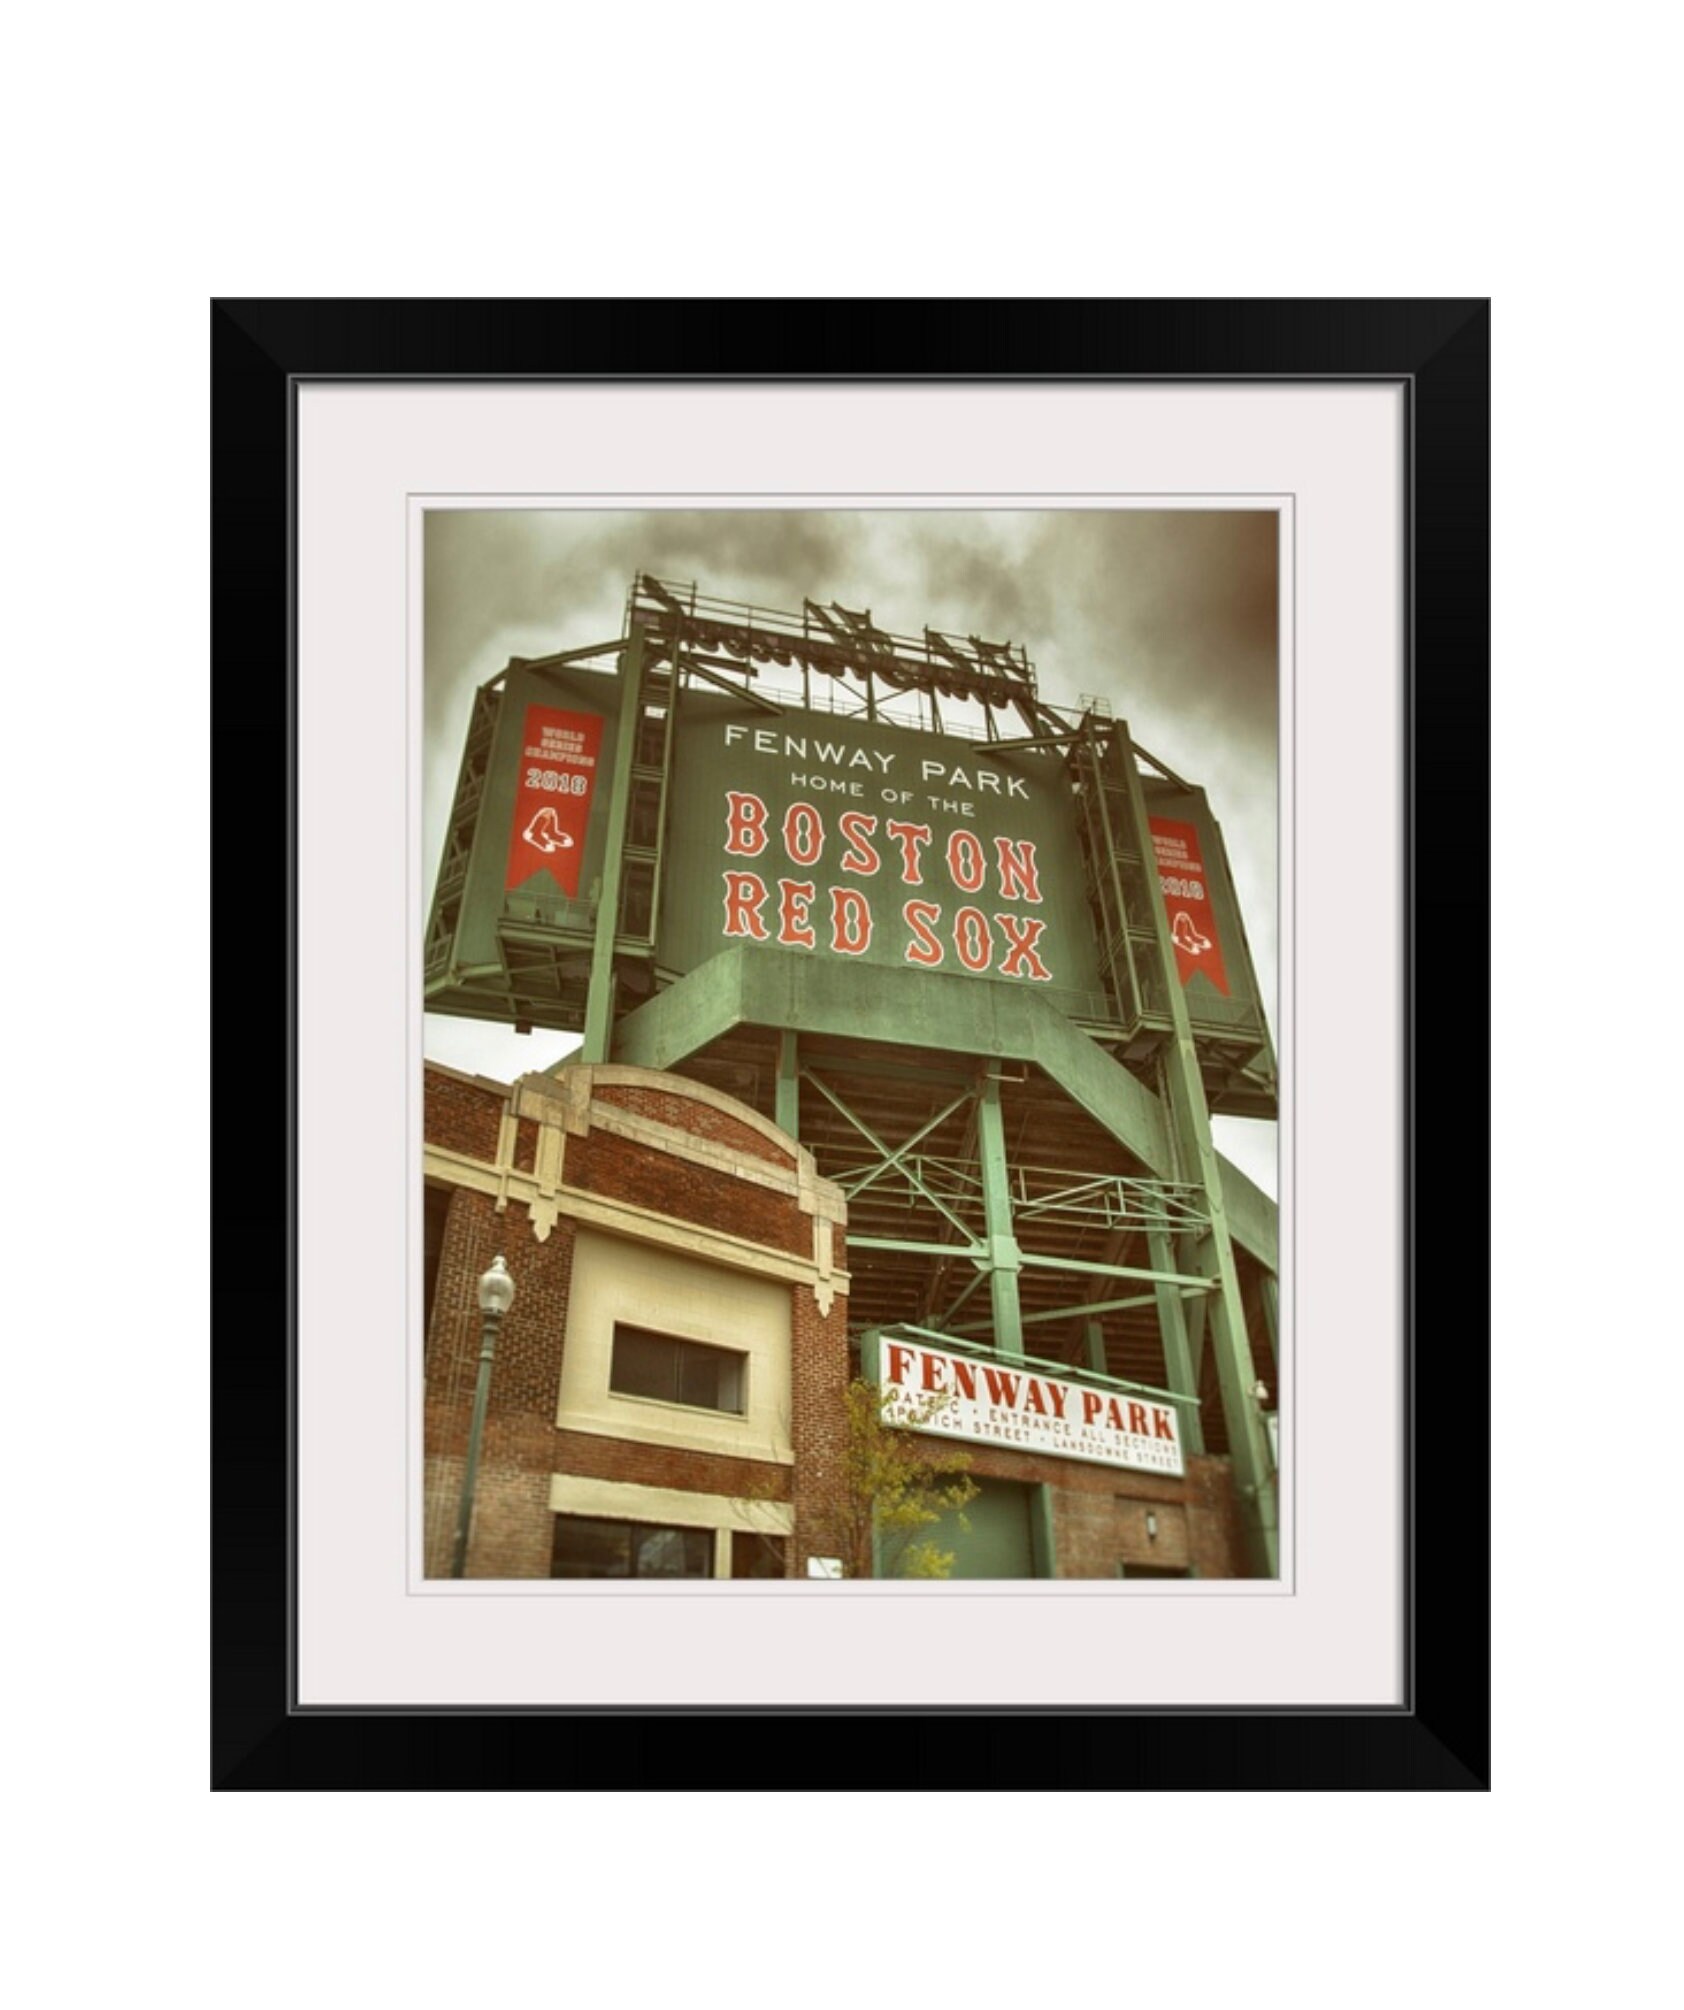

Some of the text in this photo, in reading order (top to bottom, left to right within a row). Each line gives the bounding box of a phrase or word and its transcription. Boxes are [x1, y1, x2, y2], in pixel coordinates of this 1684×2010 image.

[525, 768, 588, 796] 2018
[724, 724, 1029, 799] FENWAY PARK
[791, 773, 976, 816] HOME OF THE
[725, 792, 1043, 903] BOSTON
[723, 871, 1052, 980] RED SOX
[888, 1345, 1174, 1441] FENWAY PARK
[950, 1400, 959, 1415] C
[989, 1409, 1071, 1436] ENTRANCE
[1081, 1427, 1105, 1443] ALL
[1115, 1435, 1177, 1457] SECTIONS
[973, 1422, 1030, 1442] STREET
[1137, 1452, 1178, 1468] STREET
